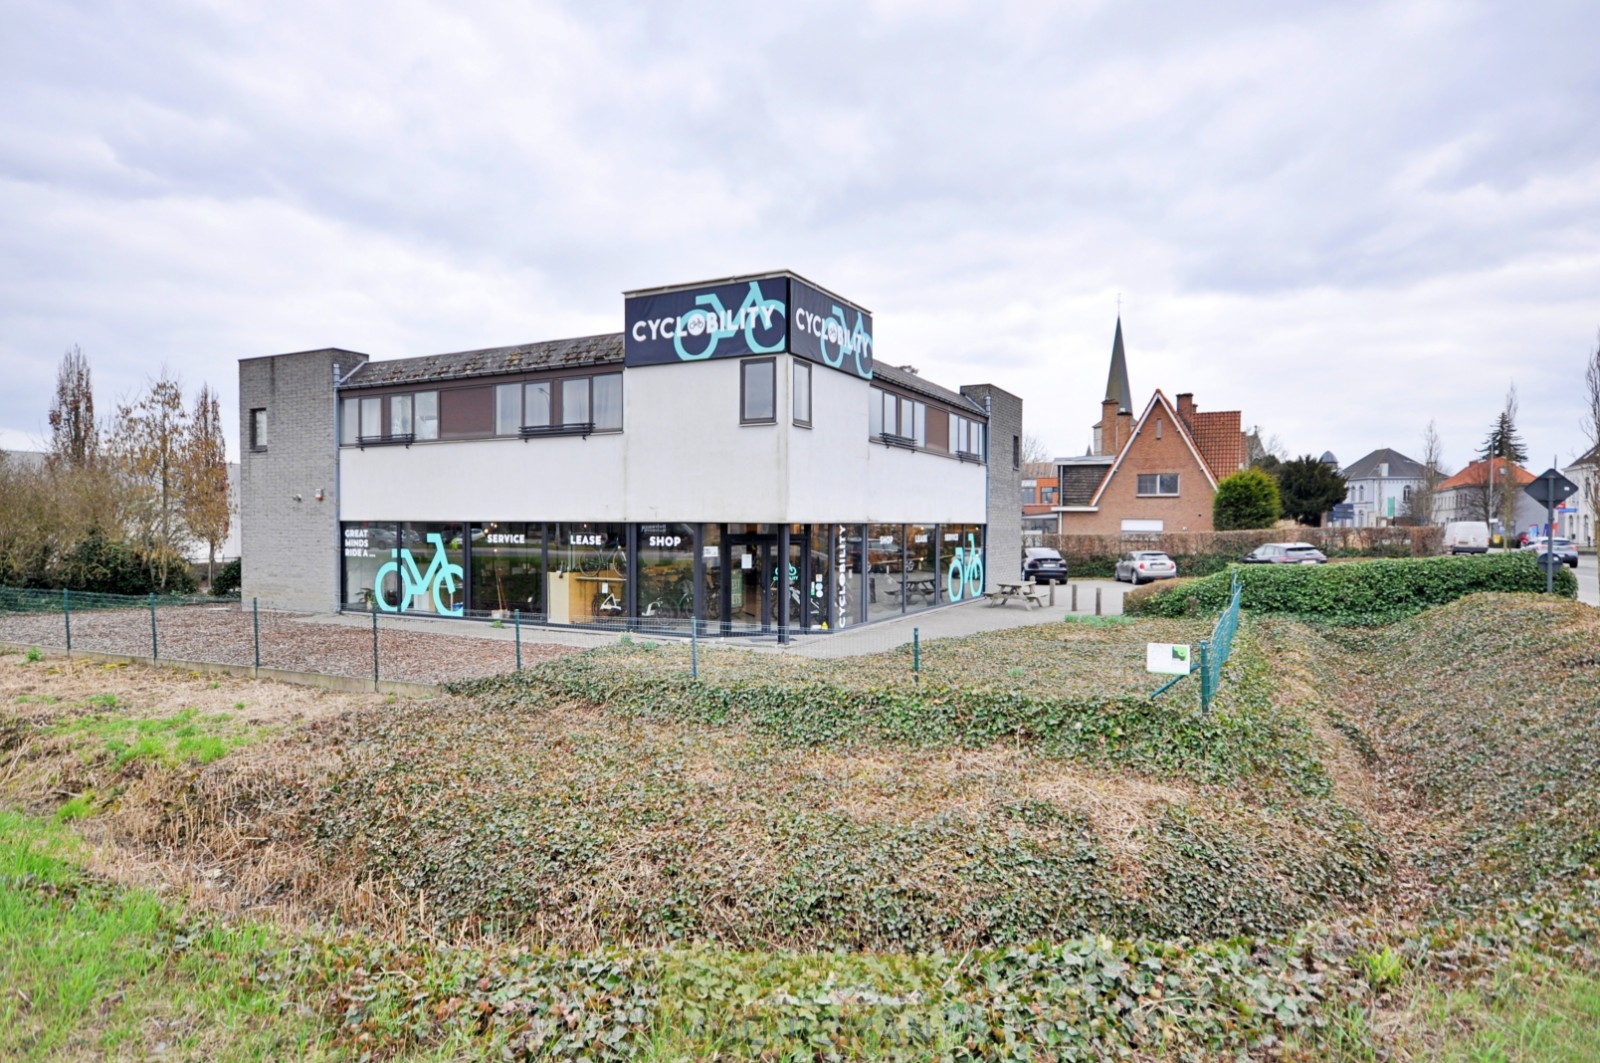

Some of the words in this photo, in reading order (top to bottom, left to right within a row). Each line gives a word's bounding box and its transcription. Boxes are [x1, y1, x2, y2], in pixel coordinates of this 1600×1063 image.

[632, 304, 776, 343] CYCLOBILITY
[795, 307, 870, 358] CYCLOBILITY
[344, 529, 369, 538] GREAT
[487, 533, 526, 545] SERVICE
[344, 539, 369, 547] MINDS
[570, 534, 602, 546] LEASE
[649, 535, 682, 547] SHOP
[344, 548, 362, 557] RIDE
[838, 525, 847, 629] CYCLOBILITY
